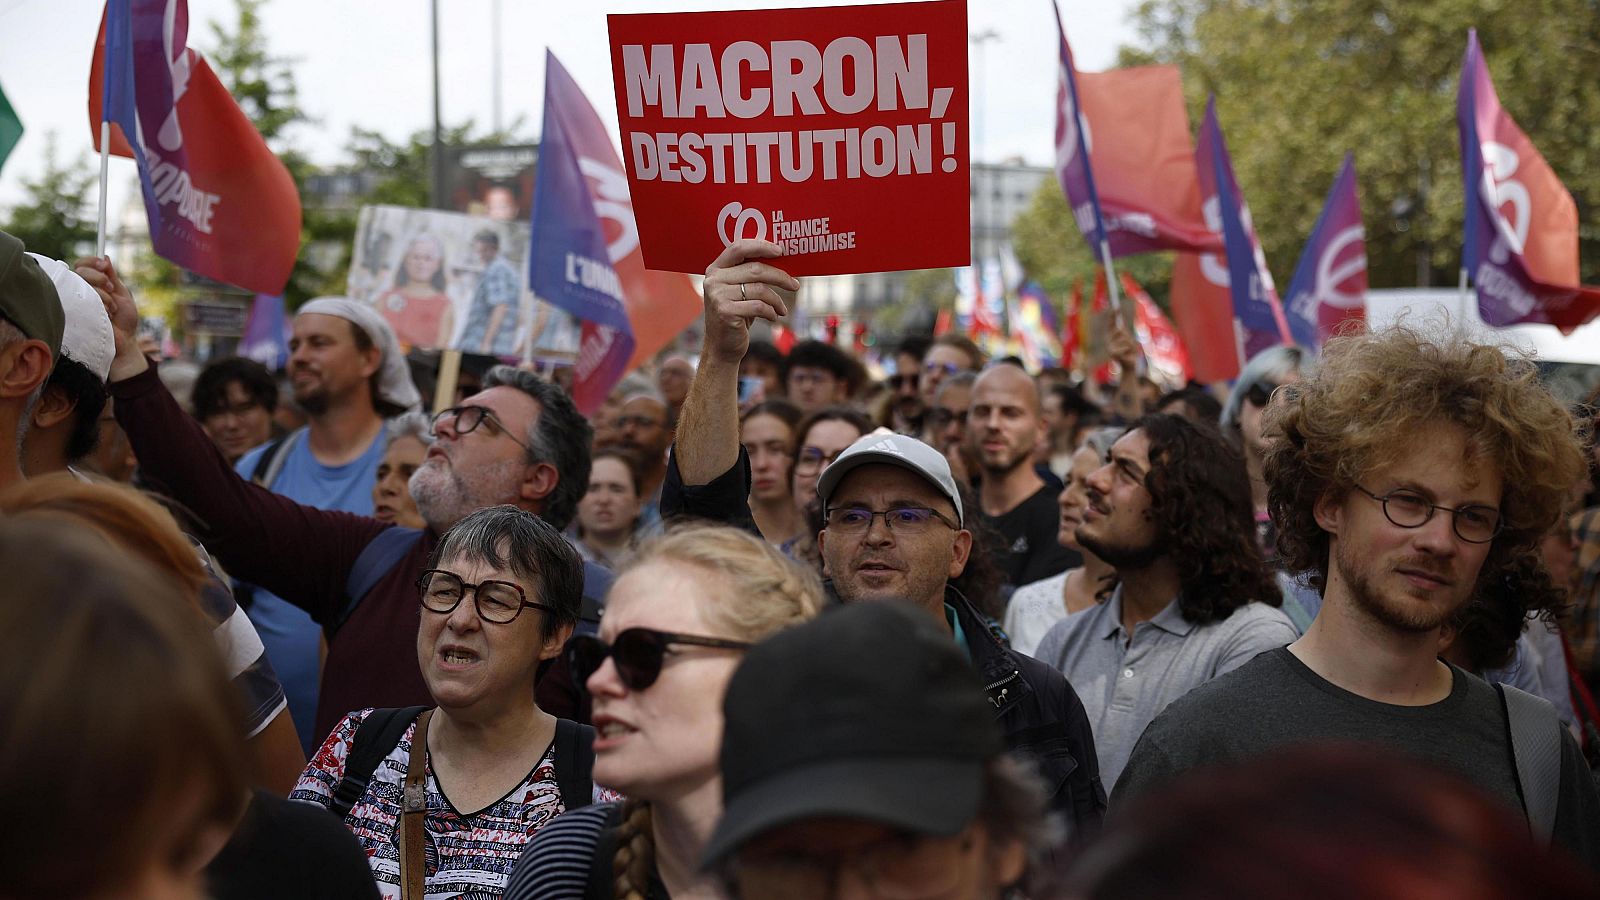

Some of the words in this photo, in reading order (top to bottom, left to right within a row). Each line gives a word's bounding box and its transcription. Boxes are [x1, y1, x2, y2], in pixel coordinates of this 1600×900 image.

[622, 33, 954, 119] MACRON,
[771, 210, 784, 223] LA
[773, 217, 830, 240] FRANCE
[774, 231, 856, 257] NSOUMISE
